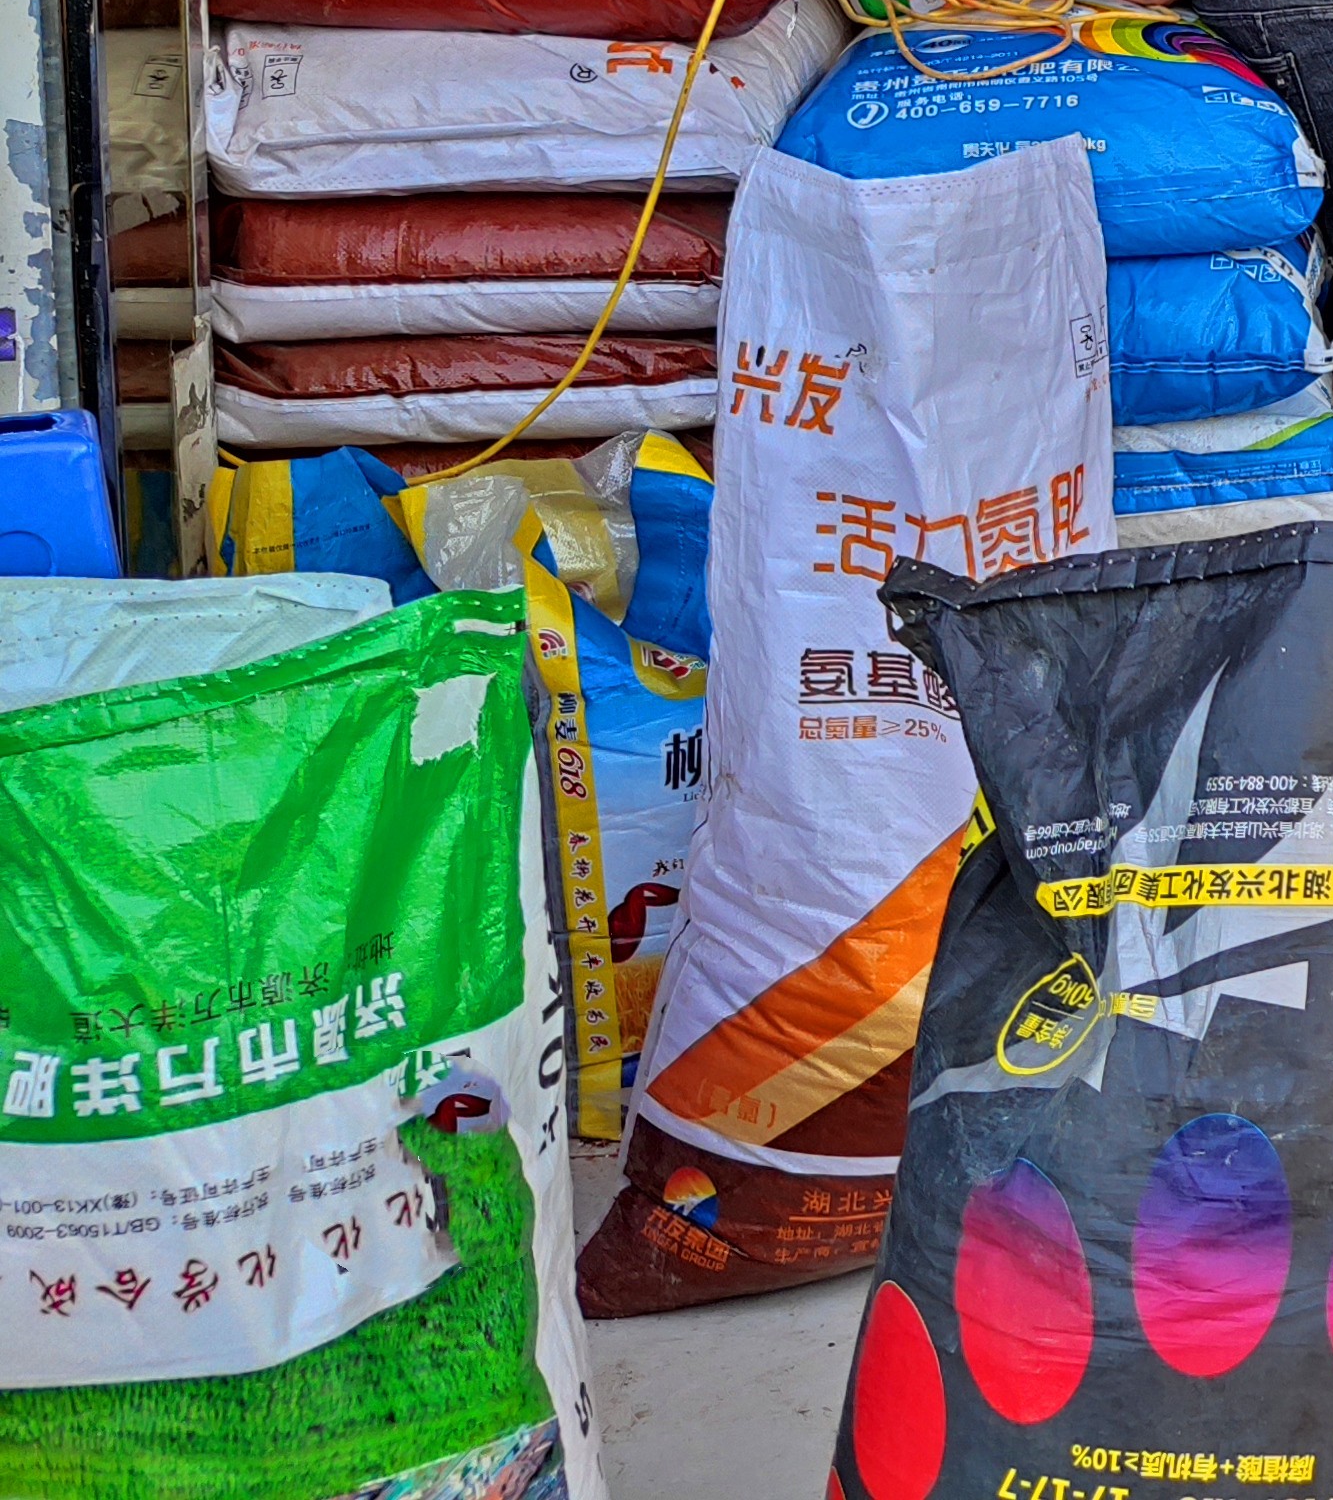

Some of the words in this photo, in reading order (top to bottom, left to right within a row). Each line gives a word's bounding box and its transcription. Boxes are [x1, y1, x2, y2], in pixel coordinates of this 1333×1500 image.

[731, 340, 850, 435] 兴发
[811, 463, 1091, 580] 活力氮肥
[799, 713, 949, 746] 总氮量≥25%
[555, 691, 588, 800] 柳麦618
[580, 951, 608, 1054] 丰收为民
[68, 961, 330, 1044] 济源市万洋大道
[1046, 972, 1096, 1010] 50kg
[2, 971, 408, 1119] 济源市万洋肥
[648, 1206, 731, 1264] 兴发集团
[680, 1249, 726, 1273] GROUP
[28, 1242, 278, 1318] 化学合成
[1069, 1443, 1317, 1483] 腐植酸+有机质≥10%
